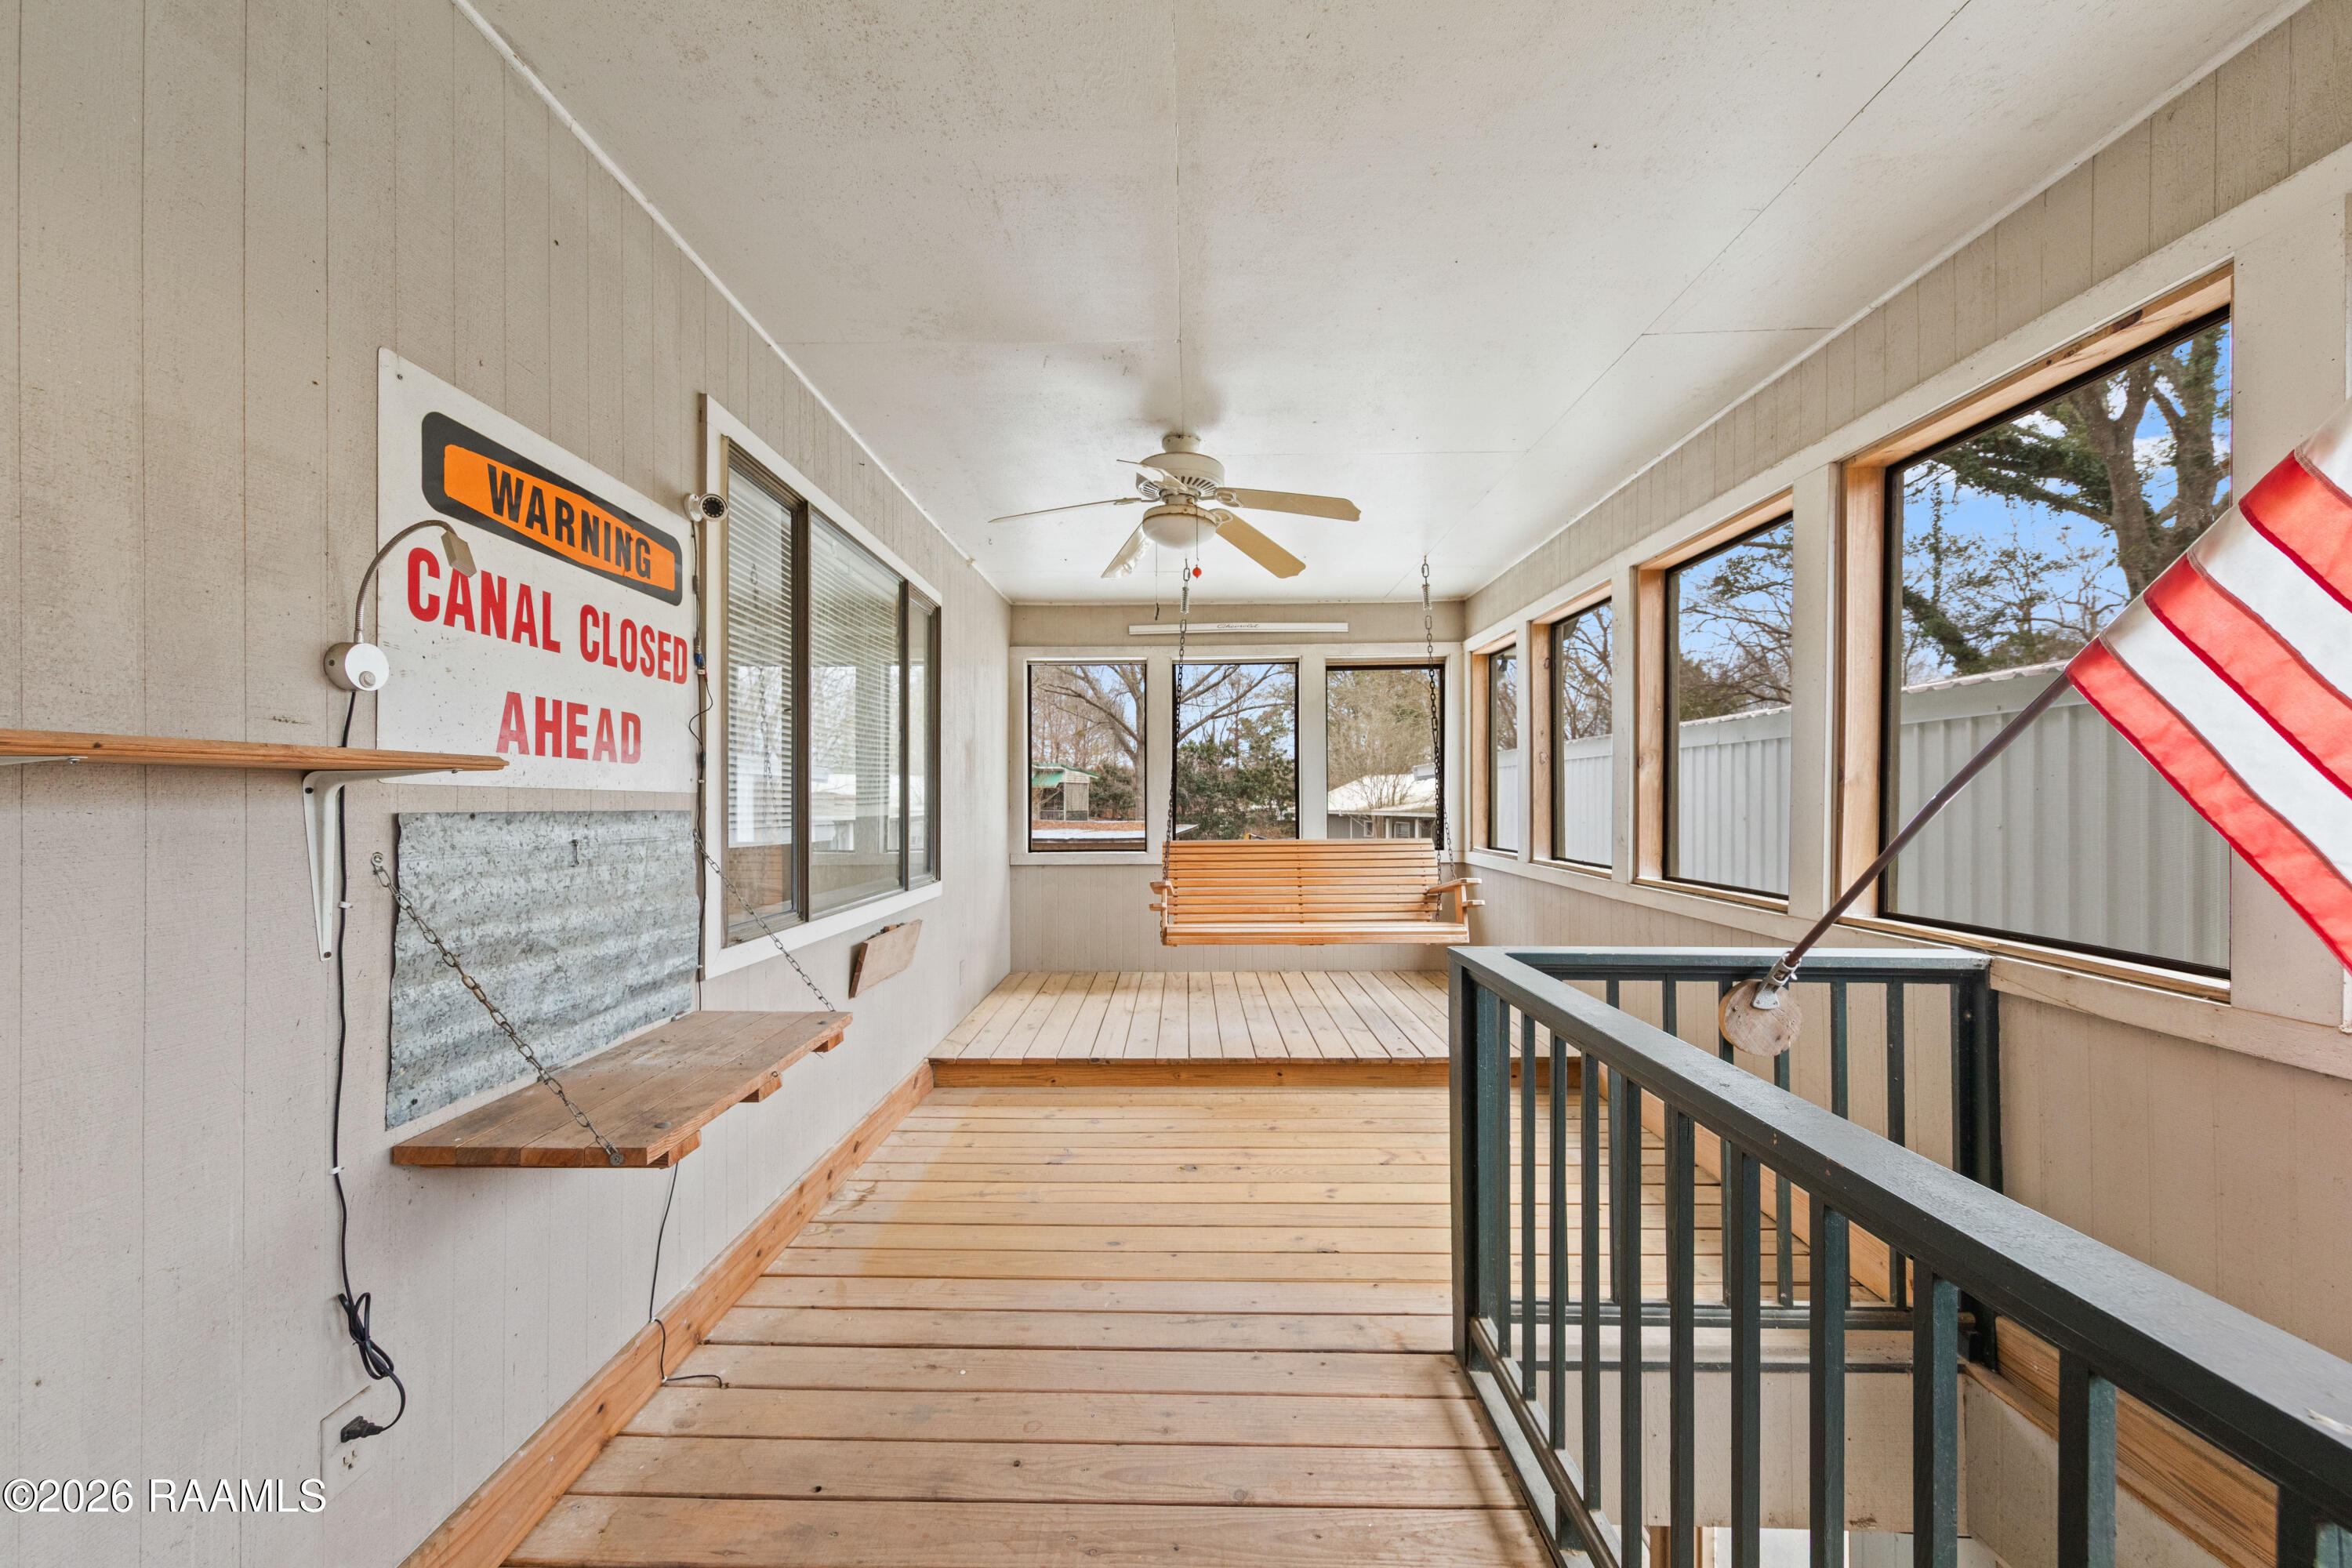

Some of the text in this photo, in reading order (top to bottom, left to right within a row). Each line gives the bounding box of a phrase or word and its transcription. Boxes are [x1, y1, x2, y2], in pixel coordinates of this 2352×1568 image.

[488, 463, 652, 580] WARNING
[408, 547, 688, 684] CANAL CLOSED
[496, 691, 641, 764] AHEAD
